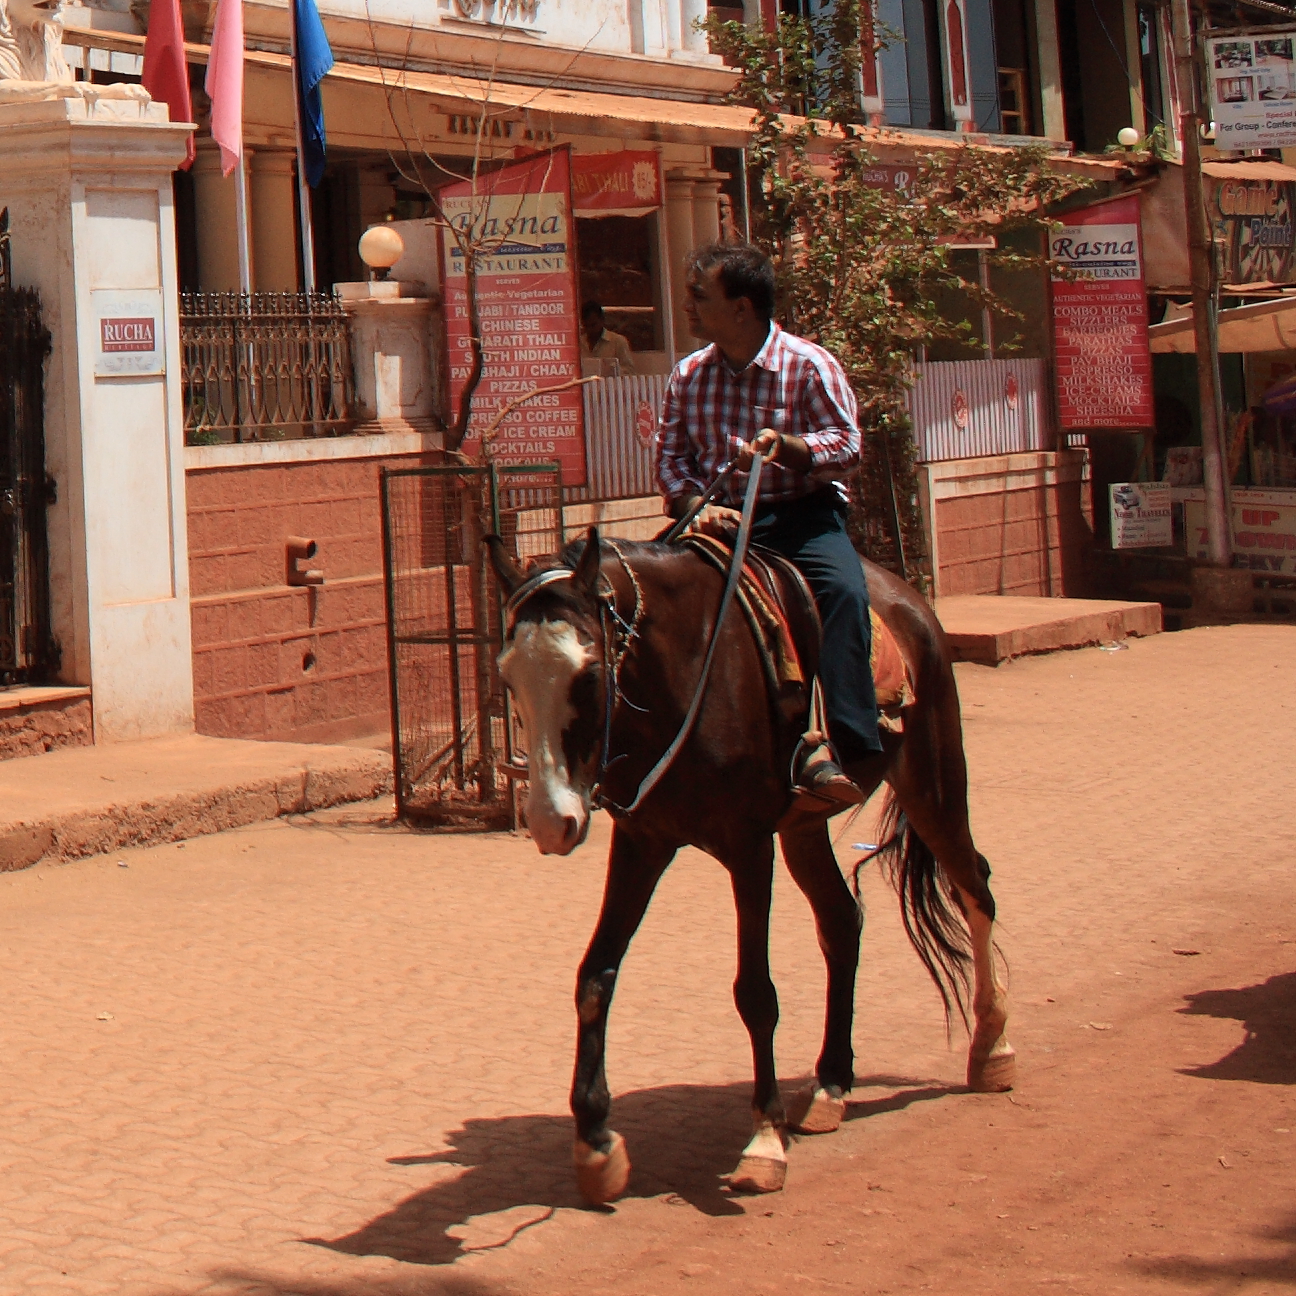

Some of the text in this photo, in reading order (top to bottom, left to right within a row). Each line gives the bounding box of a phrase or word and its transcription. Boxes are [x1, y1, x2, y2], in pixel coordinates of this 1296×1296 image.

[1219, 182, 1279, 216] Game
[1248, 217, 1291, 247] Point
[1053, 237, 1135, 260] Rasna
[453, 257, 563, 273] RSTAURANT
[454, 289, 564, 301] Auentic Vegetarian
[1053, 293, 1142, 303] AUTHENTIC VEGETARIAN
[455, 305, 503, 318] PUJABI
[511, 303, 564, 316] TANDOOR
[1054, 305, 1143, 317] COMBO MEALS
[481, 319, 540, 332] CHINESE
[1070, 315, 1128, 326] SIZZLERS
[104, 323, 152, 341] RUCHA
[1062, 325, 1137, 337] BARBEQUES
[457, 333, 566, 348] GARATI THALI
[1069, 335, 1133, 346] PARATHAS
[464, 349, 561, 363] SUTH INDIAN
[1080, 346, 1123, 356] PIZZAS
[1071, 356, 1132, 366] PAV BHAJI
[480, 364, 520, 378] BHAJI
[530, 364, 575, 377] CHAAT
[1072, 365, 1133, 376] ESPRESSO
[489, 380, 538, 393] PIZZAS
[1062, 375, 1143, 386] MILKSHAKES
[1065, 385, 1142, 396] ICE-CREAMS
[470, 396, 501, 409] MILK
[1068, 395, 1140, 406] MOCKTAILS
[1076, 405, 1133, 416] SHEESHA
[453, 410, 578, 425] PRESO COFFEE
[1071, 416, 1090, 426] and
[504, 427, 526, 439] ICE
[529, 425, 576, 437] CREAM
[489, 441, 555, 454] OCKTAILS
[1234, 531, 1296, 551] OWN
